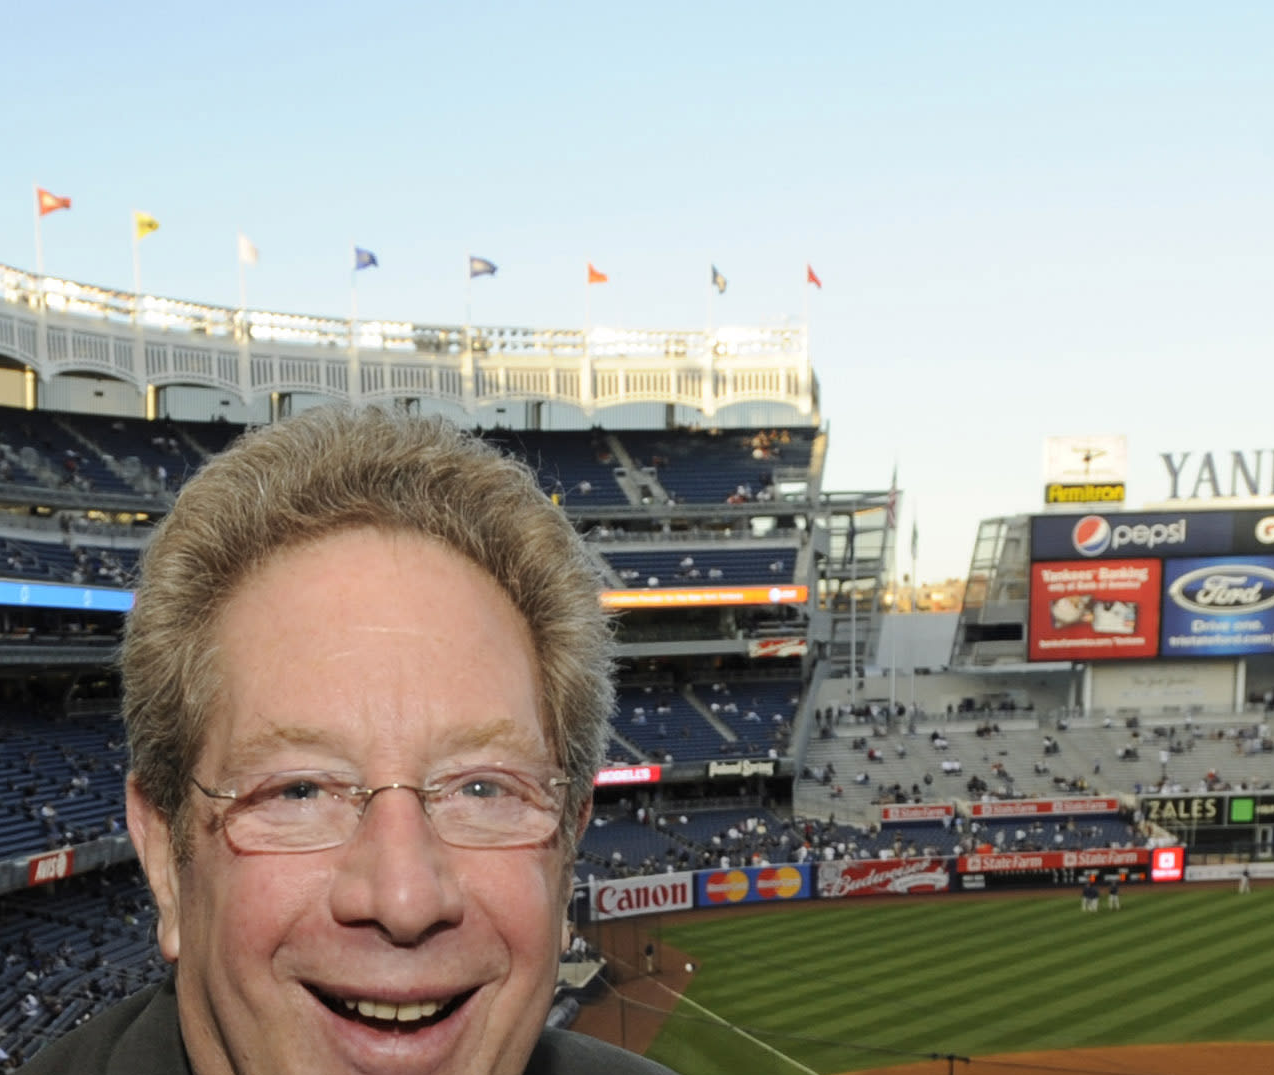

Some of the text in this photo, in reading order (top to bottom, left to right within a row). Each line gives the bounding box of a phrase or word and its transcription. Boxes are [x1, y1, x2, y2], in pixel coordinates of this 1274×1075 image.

[1111, 519, 1186, 550] pepsi
[1196, 575, 1263, 605] Ford
[1191, 620, 1230, 633] Drive
[1148, 799, 1217, 819] ZALES
[833, 858, 934, 897] Budweiser
[596, 882, 688, 914] Canon
